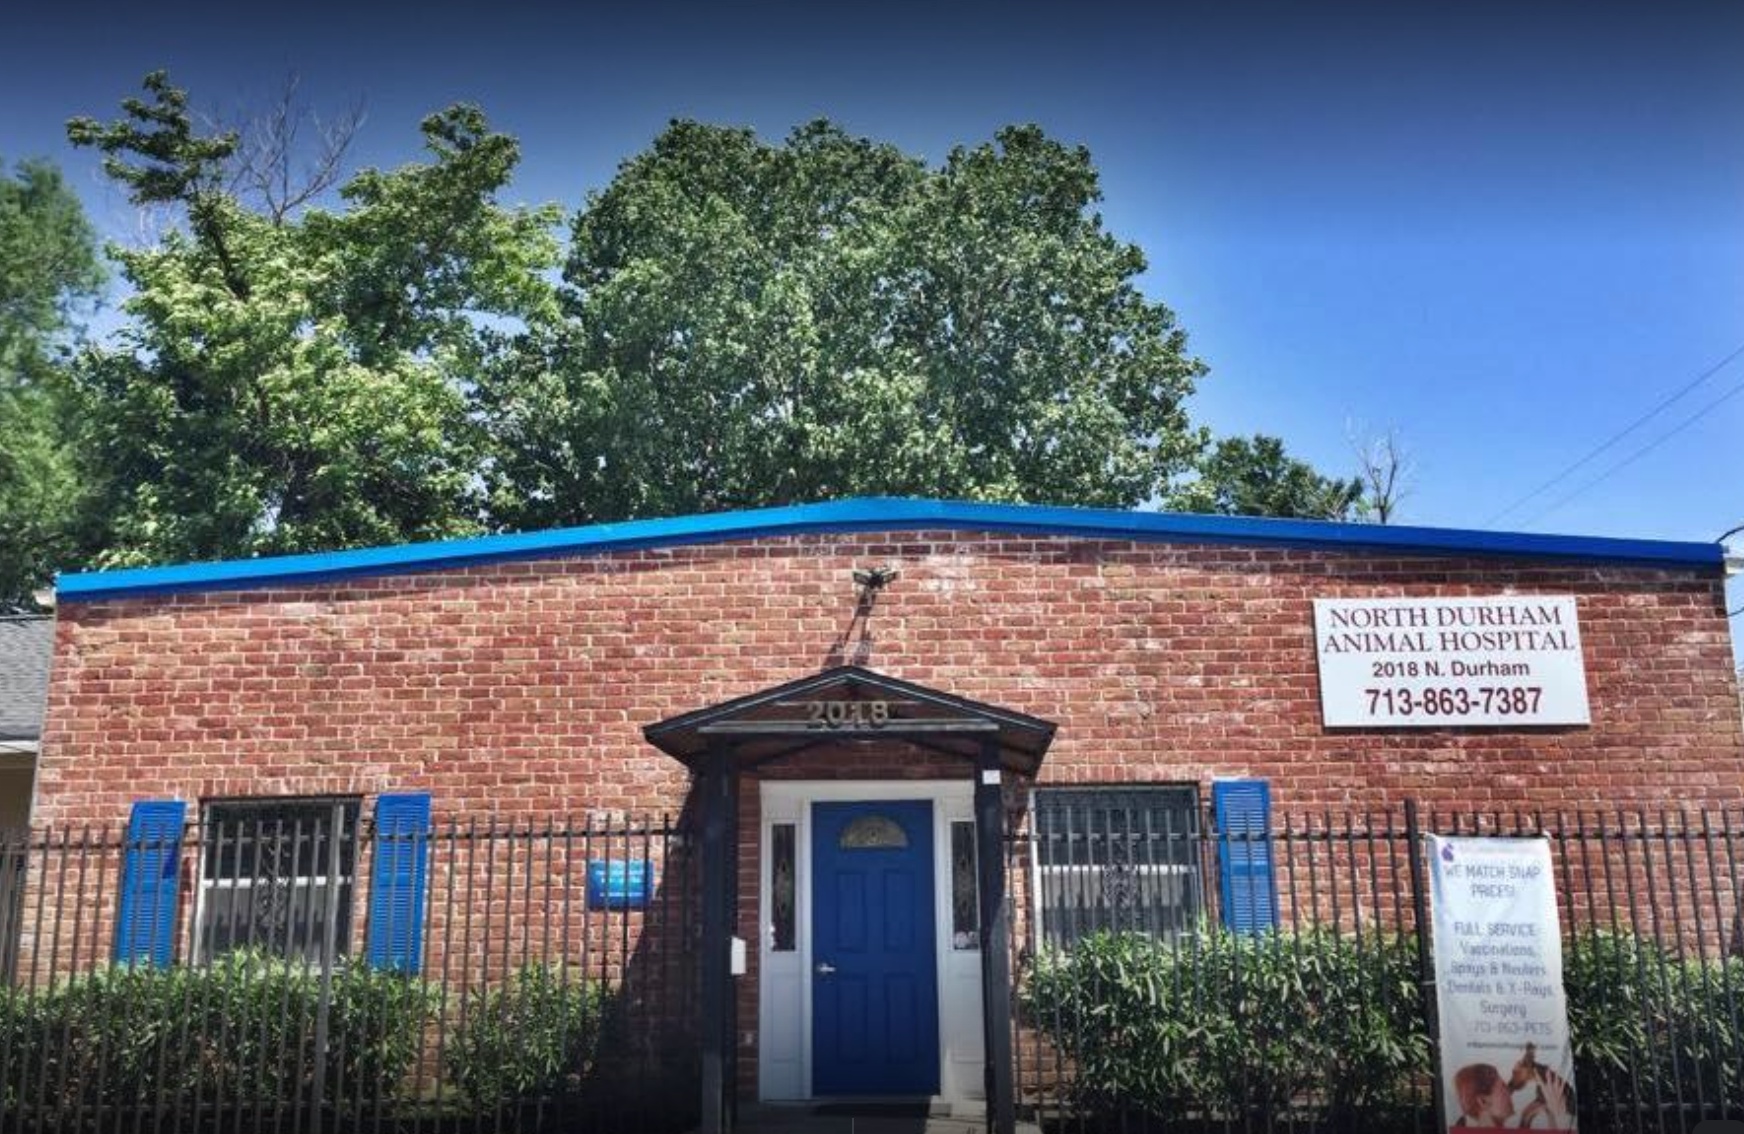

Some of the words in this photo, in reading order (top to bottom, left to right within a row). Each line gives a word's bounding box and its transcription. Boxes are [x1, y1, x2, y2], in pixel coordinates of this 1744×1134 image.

[1330, 607, 1428, 628] NORTH
[1437, 606, 1561, 626] DURHAM
[1324, 631, 1432, 652] ANIMAL
[1441, 630, 1575, 651] HOSPITAL
[1373, 661, 1418, 678] 2018
[1425, 661, 1445, 677] N.
[1452, 660, 1530, 677] Durham
[1365, 687, 1542, 716] 713-863-7387
[806, 701, 888, 725] 2018
[1466, 864, 1505, 879] MATCH
[1508, 864, 1540, 879] SNAP
[1454, 922, 1481, 936] FULL
[1488, 923, 1538, 937] SERVICE
[1480, 1001, 1527, 1018] Surgery
